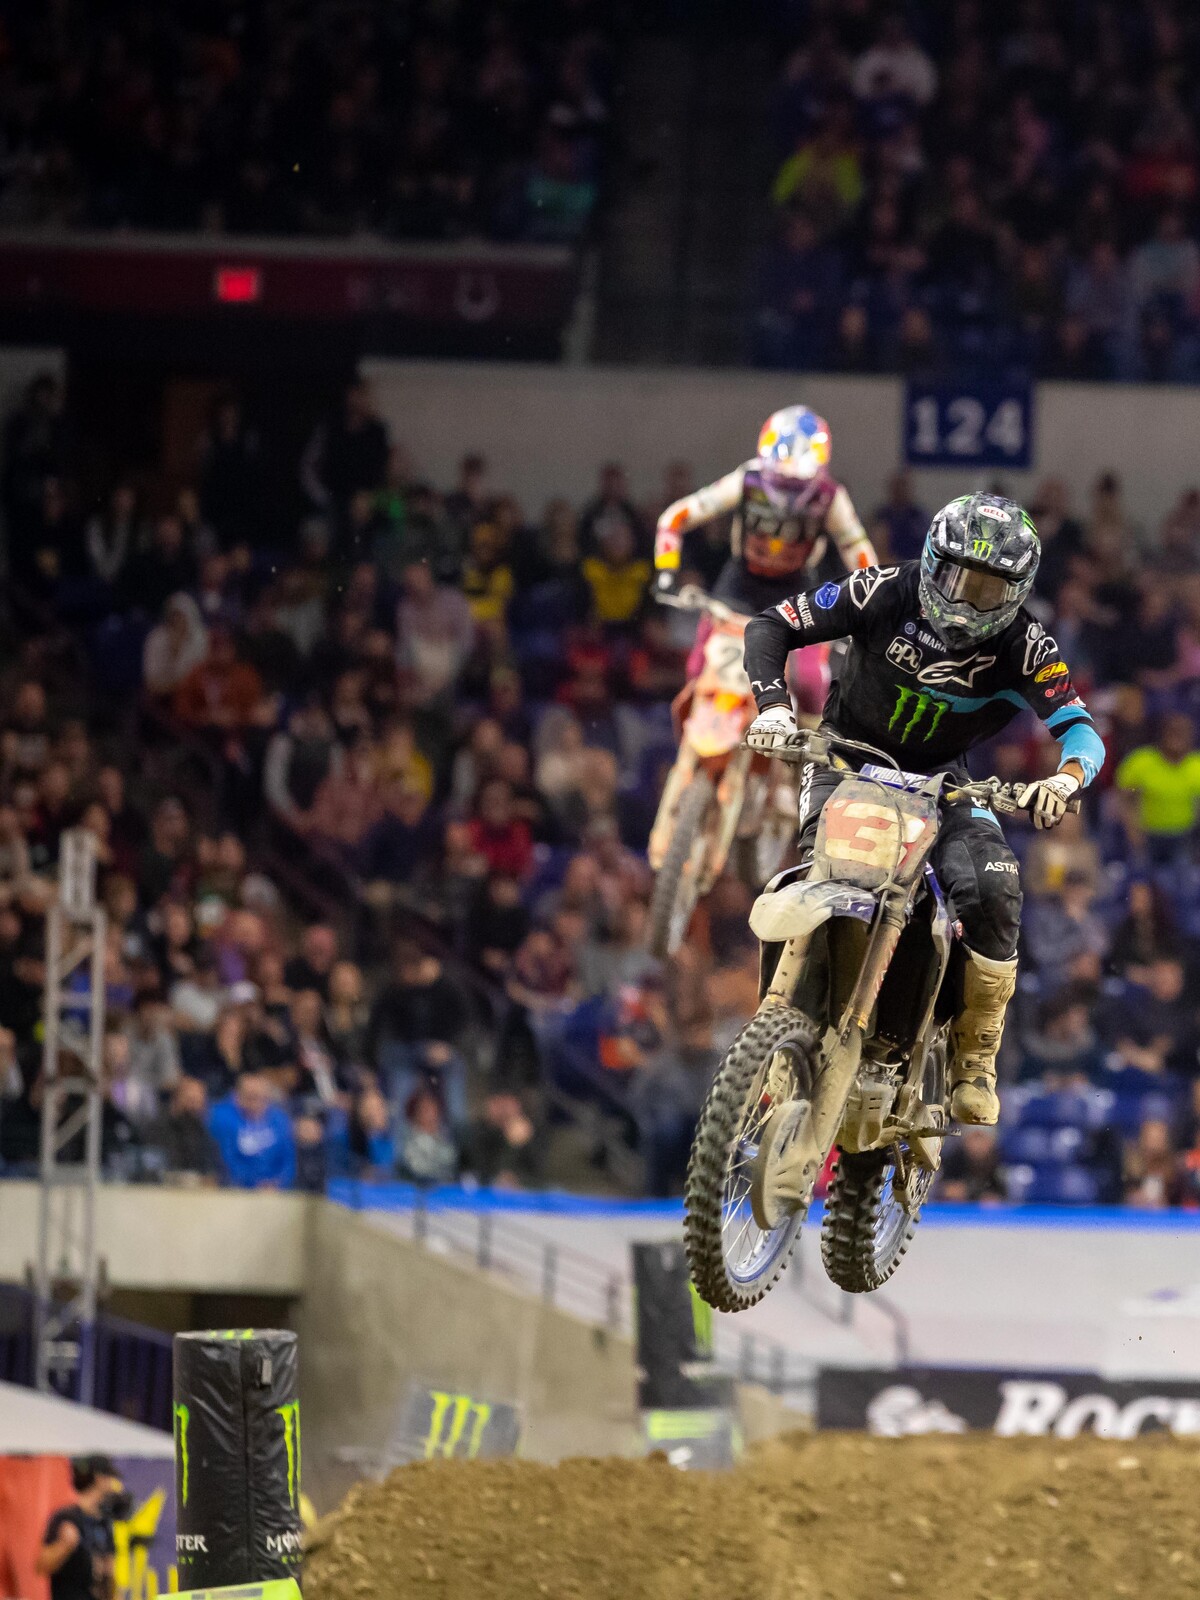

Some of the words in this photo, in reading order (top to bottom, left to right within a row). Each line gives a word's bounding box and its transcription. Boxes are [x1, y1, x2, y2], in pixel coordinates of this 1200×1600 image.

[914, 396, 1023, 455] 124
[983, 507, 1006, 519] BELL
[916, 630, 947, 653] AMAHA
[825, 802, 927, 869] 3
